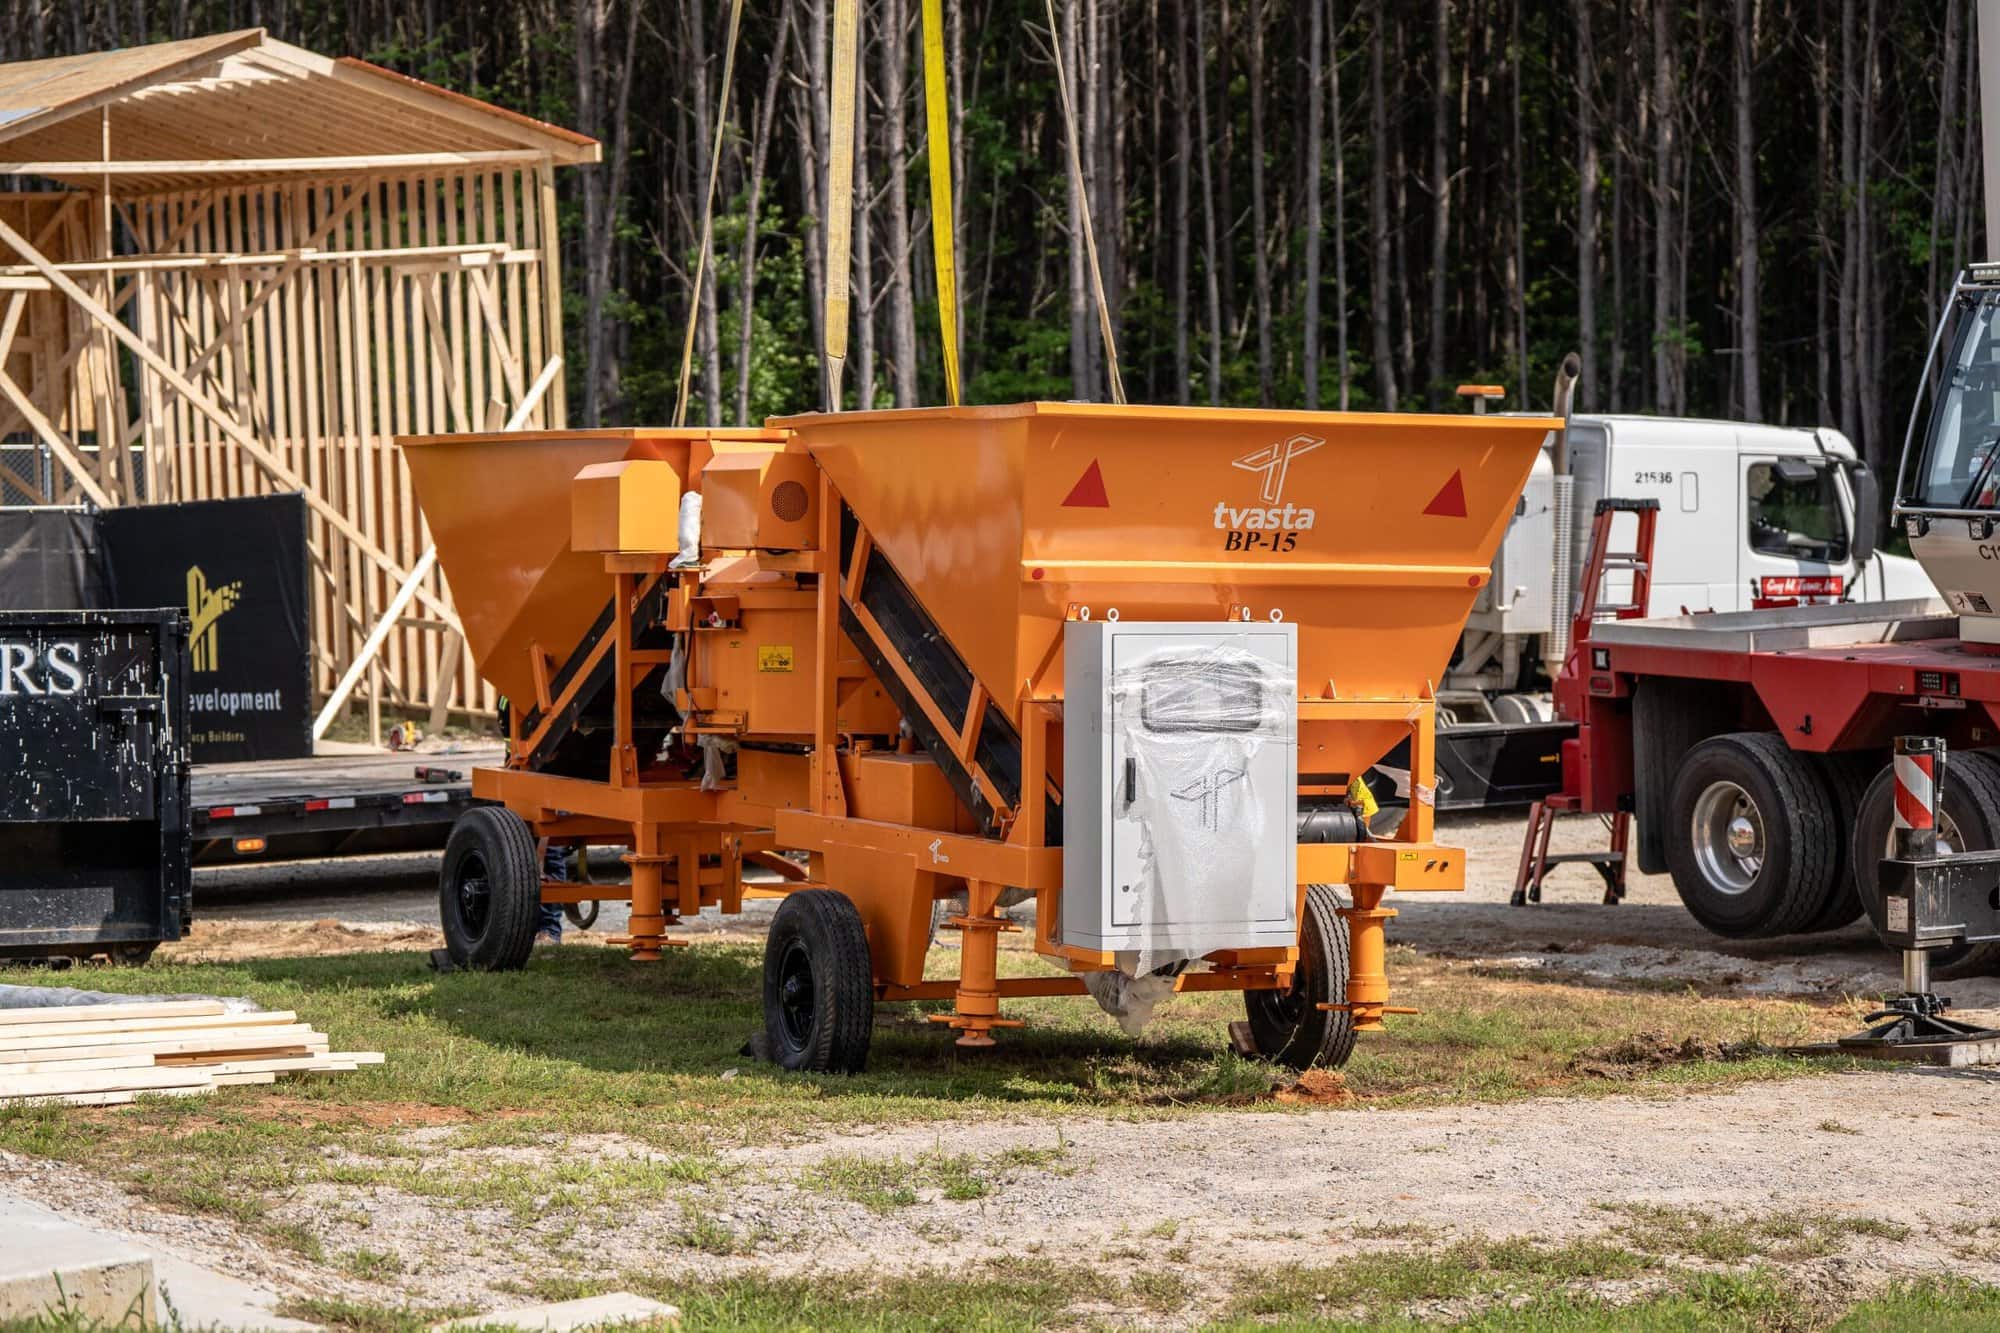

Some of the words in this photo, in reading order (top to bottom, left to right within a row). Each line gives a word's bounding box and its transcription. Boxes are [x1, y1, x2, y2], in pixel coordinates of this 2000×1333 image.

[1634, 471, 1673, 483] 21536
[1213, 501, 1316, 530] tvasta
[1224, 531, 1298, 553] BP-15
[0, 642, 83, 695] RS
